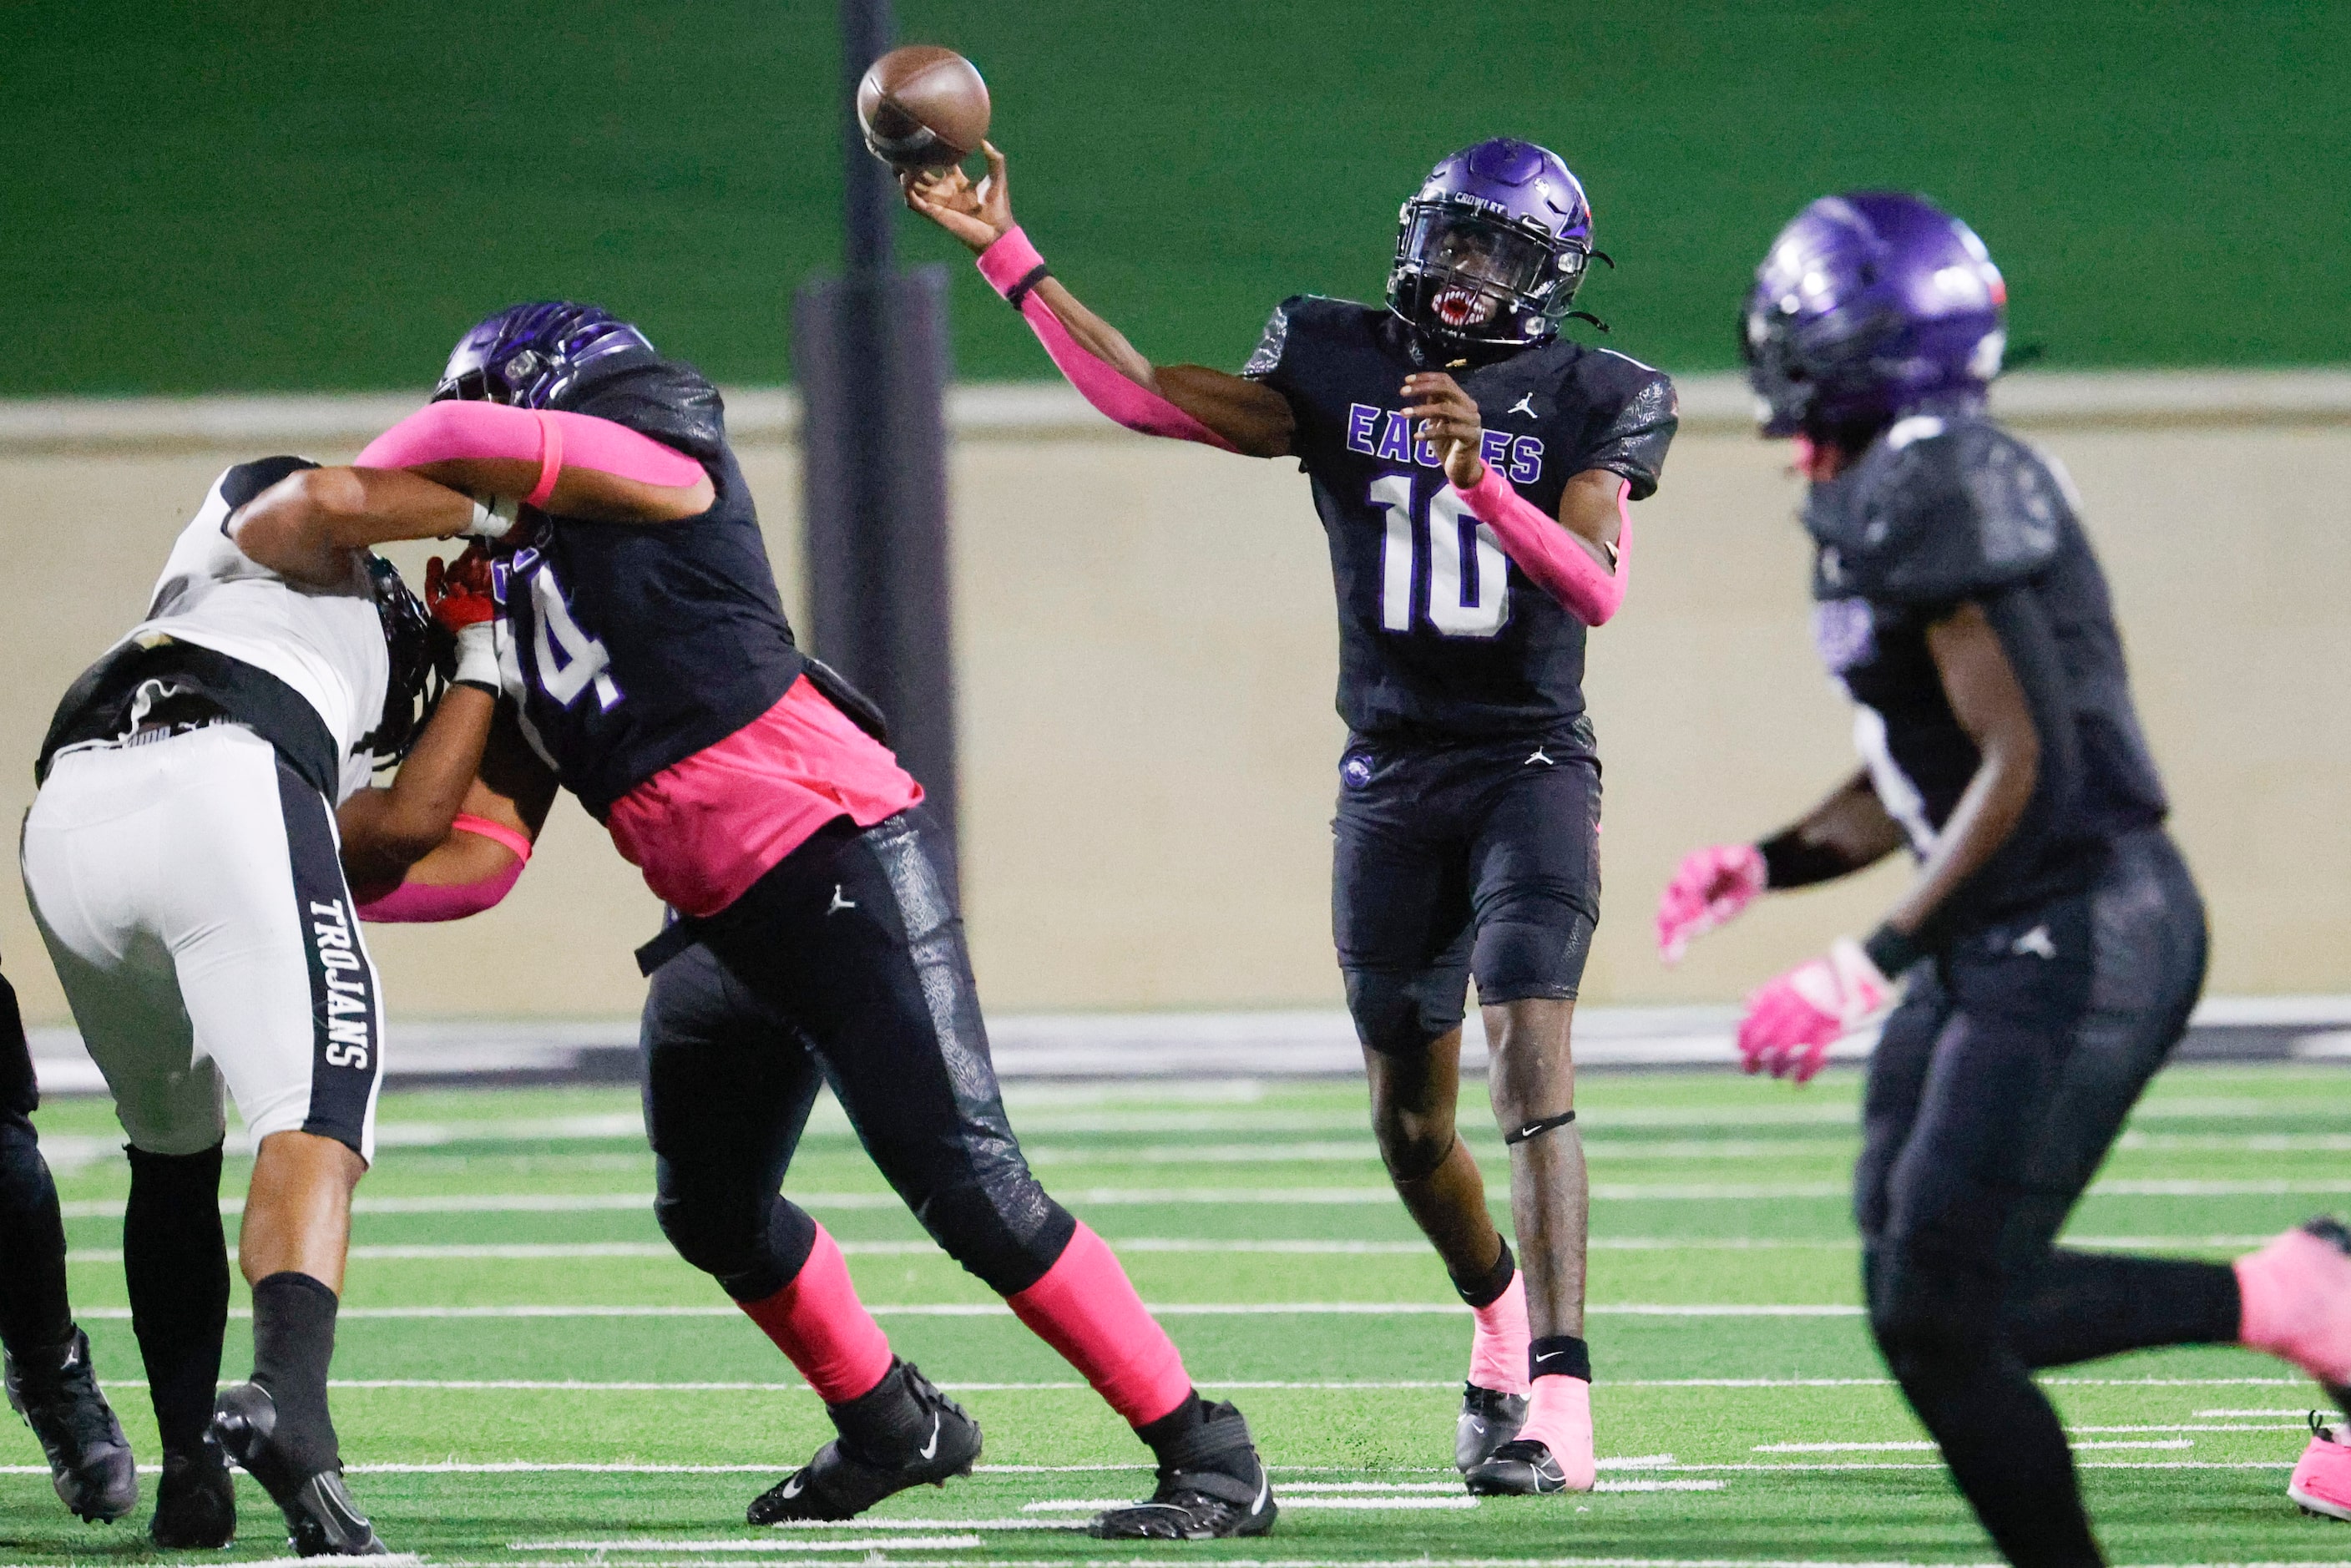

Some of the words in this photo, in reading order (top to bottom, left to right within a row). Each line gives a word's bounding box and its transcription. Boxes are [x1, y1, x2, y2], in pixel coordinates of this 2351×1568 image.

[1454, 191, 1507, 214] CROWLEY
[1347, 402, 1545, 483] EAGES
[1368, 473, 1511, 639] 10
[310, 898, 368, 1070] TROJANS
